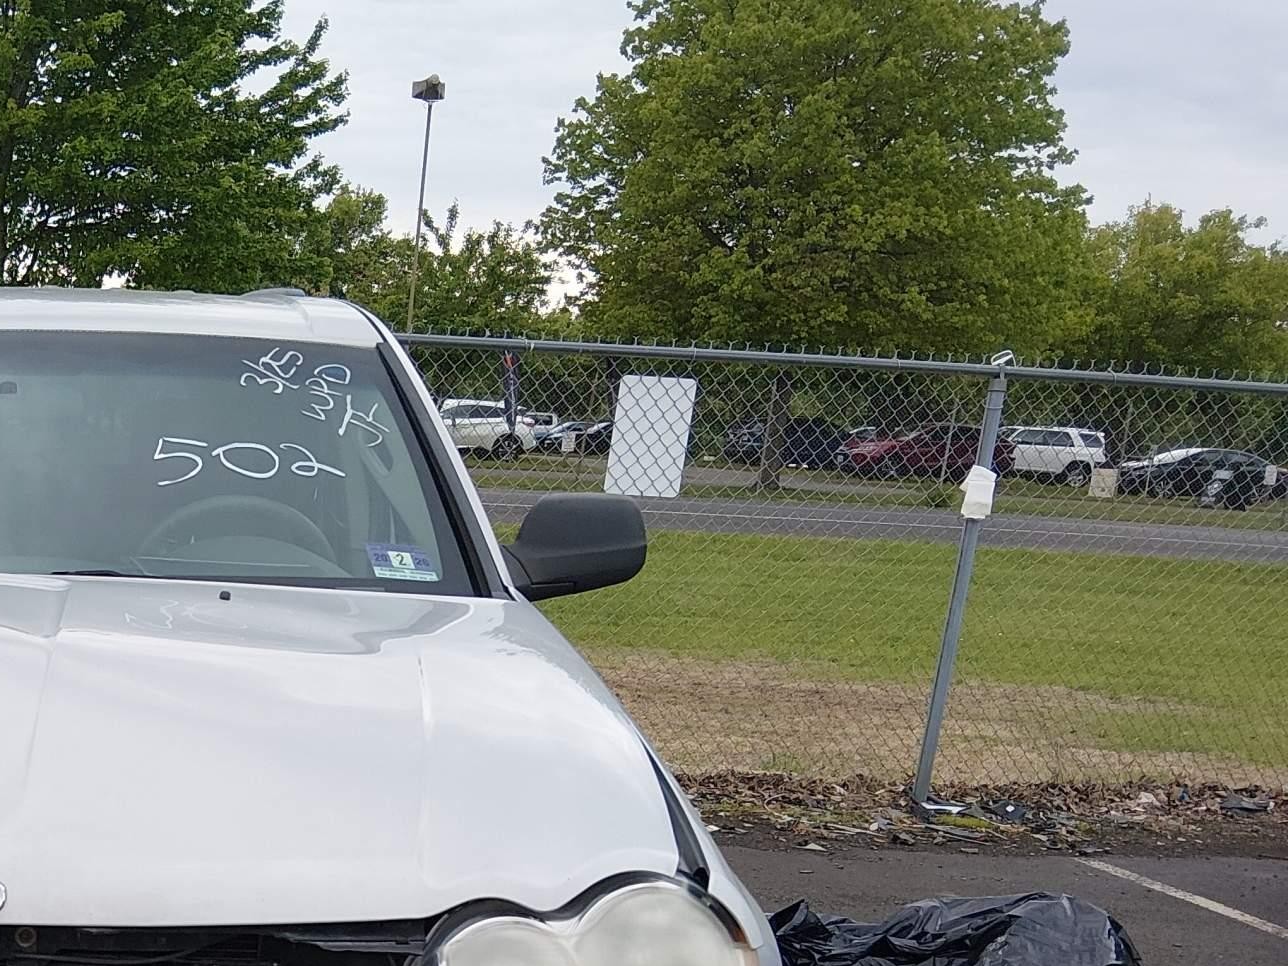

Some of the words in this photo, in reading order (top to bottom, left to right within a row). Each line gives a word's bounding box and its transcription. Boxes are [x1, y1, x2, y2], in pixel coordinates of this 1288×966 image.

[301, 364, 351, 421] WPD
[153, 436, 346, 486] 502
[395, 553, 407, 566] 2
